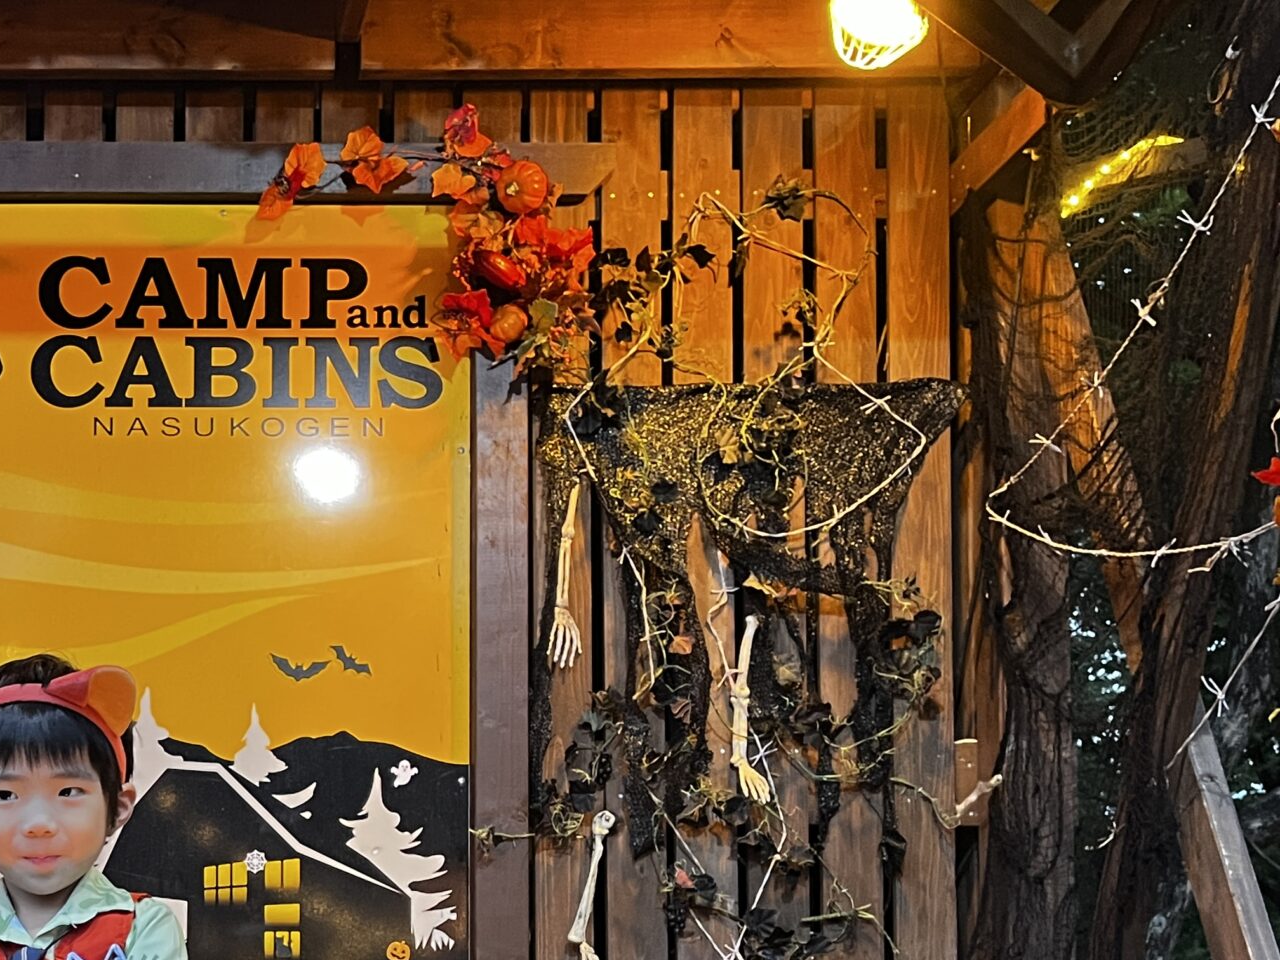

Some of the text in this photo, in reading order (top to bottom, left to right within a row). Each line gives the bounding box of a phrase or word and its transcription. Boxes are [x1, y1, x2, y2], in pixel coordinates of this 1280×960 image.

[38, 255, 429, 330] CAMP and
[30, 334, 444, 410] CABINS
[92, 416, 385, 437] NASUKOGEN
